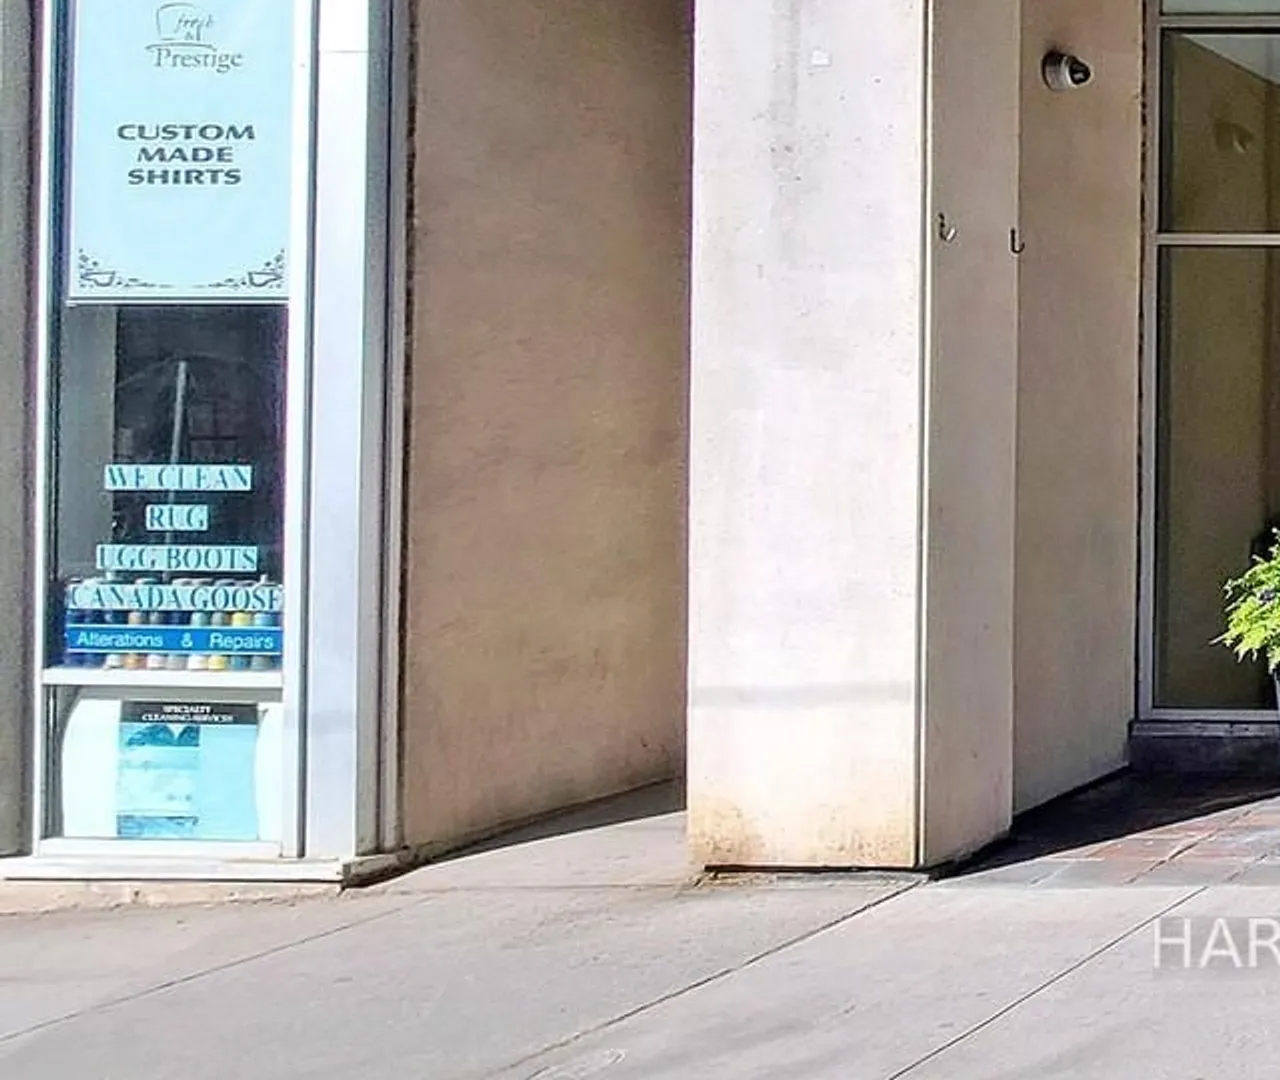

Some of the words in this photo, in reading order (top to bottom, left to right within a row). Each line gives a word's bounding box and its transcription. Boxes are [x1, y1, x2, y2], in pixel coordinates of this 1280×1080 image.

[154, 48, 244, 74] Prestige
[116, 123, 256, 140] CUSTOM
[137, 146, 235, 163] MADE
[127, 168, 242, 185] SHIRTS
[107, 466, 146, 488] WE
[158, 466, 250, 488] CLEAN
[150, 506, 205, 529] RUG
[99, 546, 158, 569] UGG
[166, 546, 257, 569] BOOTS
[71, 585, 182, 609] CANADA
[77, 631, 163, 648] Alterations
[180, 632, 193, 648] &
[209, 632, 274, 651] Repairs
